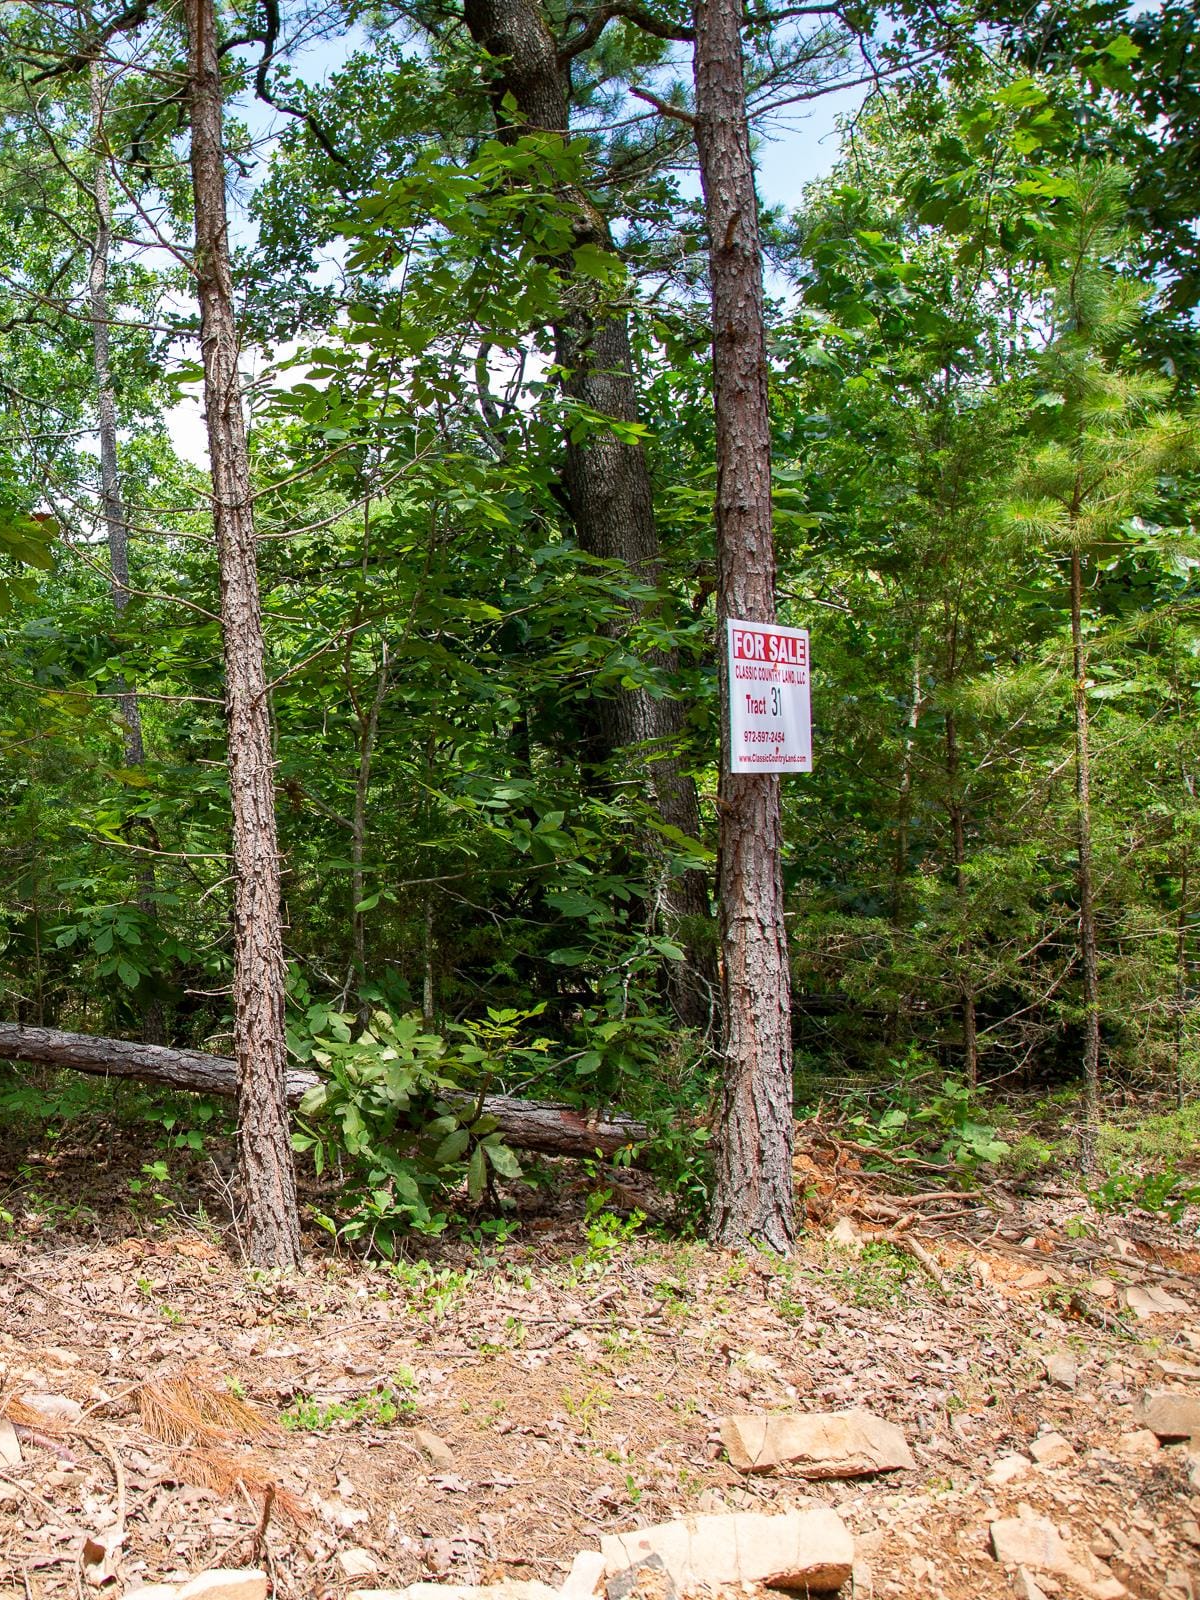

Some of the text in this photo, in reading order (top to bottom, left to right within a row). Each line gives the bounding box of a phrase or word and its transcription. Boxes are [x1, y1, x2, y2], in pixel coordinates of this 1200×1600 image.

[733, 631, 806, 665] FOR SALE
[735, 665, 757, 680] CLASSIC
[758, 667, 781, 682] COUNTRY
[797, 671, 806, 684] LLC
[746, 686, 782, 716] Tract 31
[744, 731, 785, 743] 972-597-2454
[739, 753, 807, 764] www.ClassicCountryLand.com
